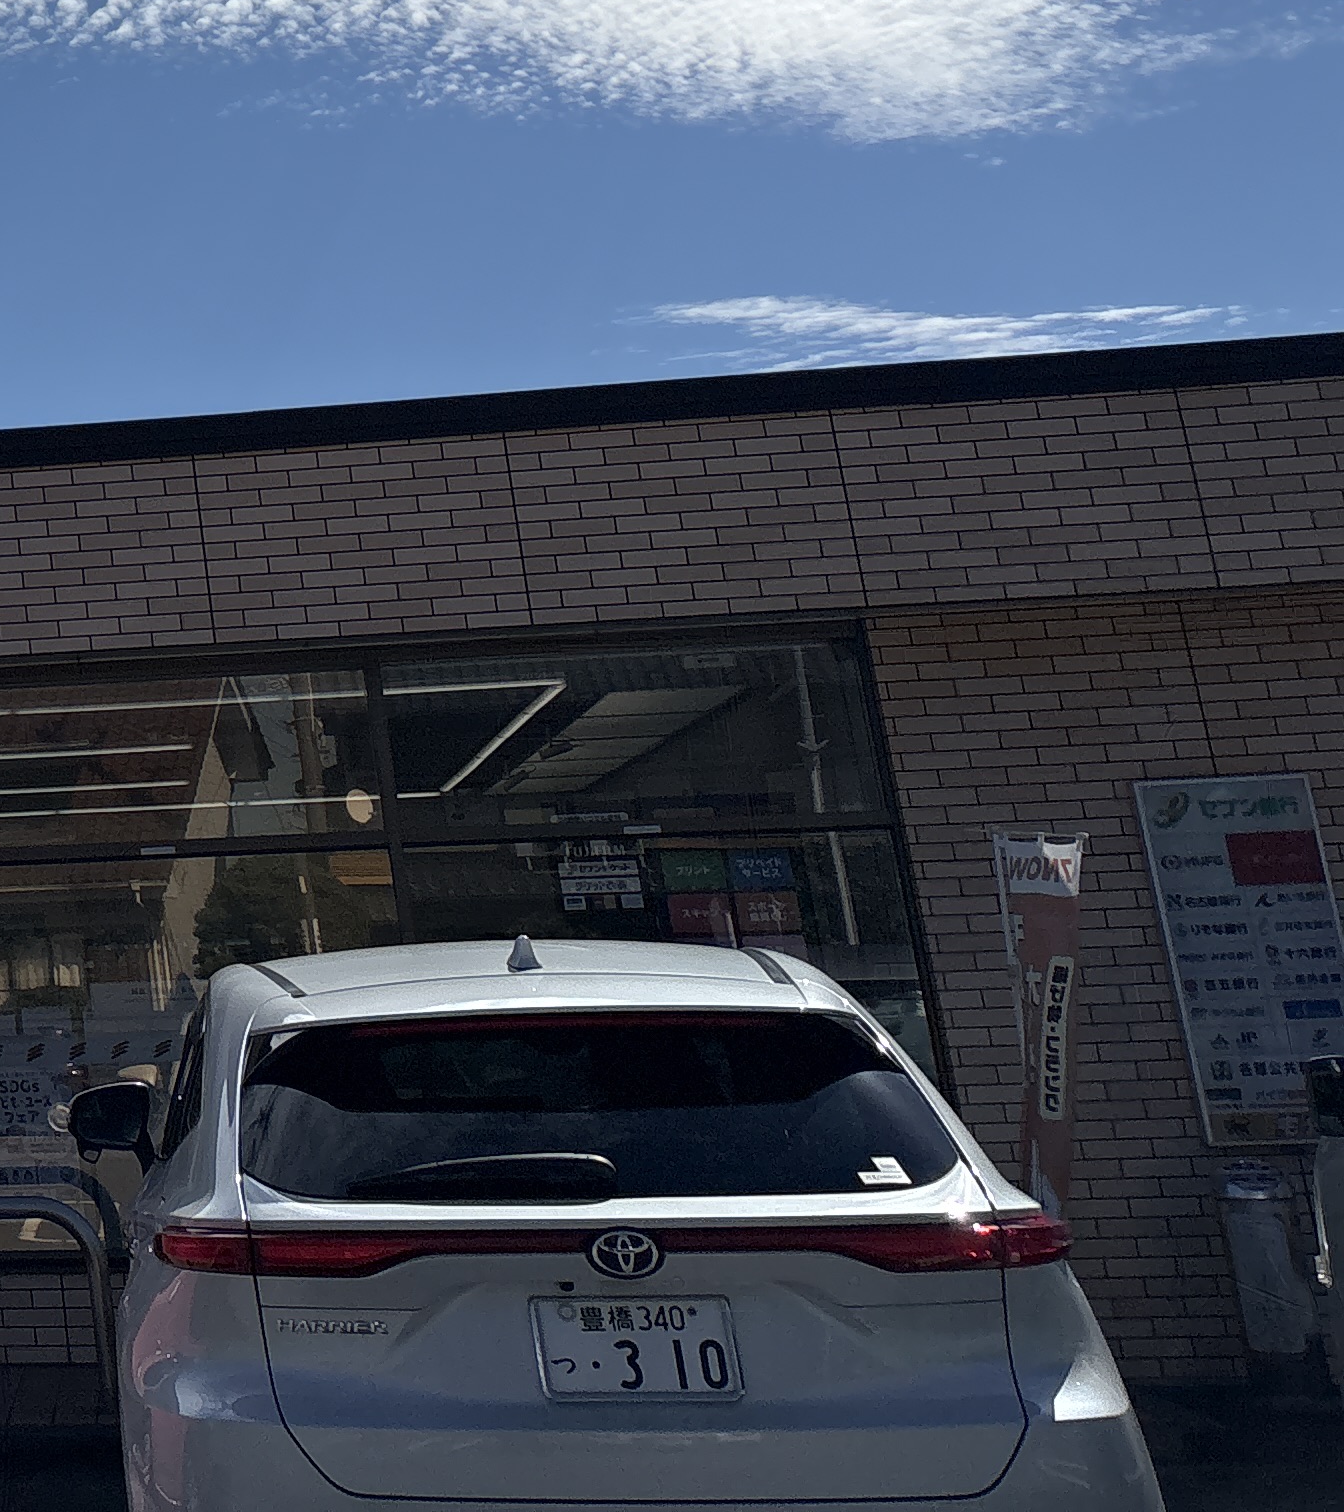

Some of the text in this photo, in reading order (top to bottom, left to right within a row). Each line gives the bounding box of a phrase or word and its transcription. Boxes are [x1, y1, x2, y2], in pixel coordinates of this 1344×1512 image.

[1199, 796, 1300, 820] セブン銀行
[675, 865, 711, 877] プリント
[0, 1080, 40, 1094] SDGs
[4, 1110, 41, 1124] フェア
[276, 1318, 389, 1335] HARRIER
